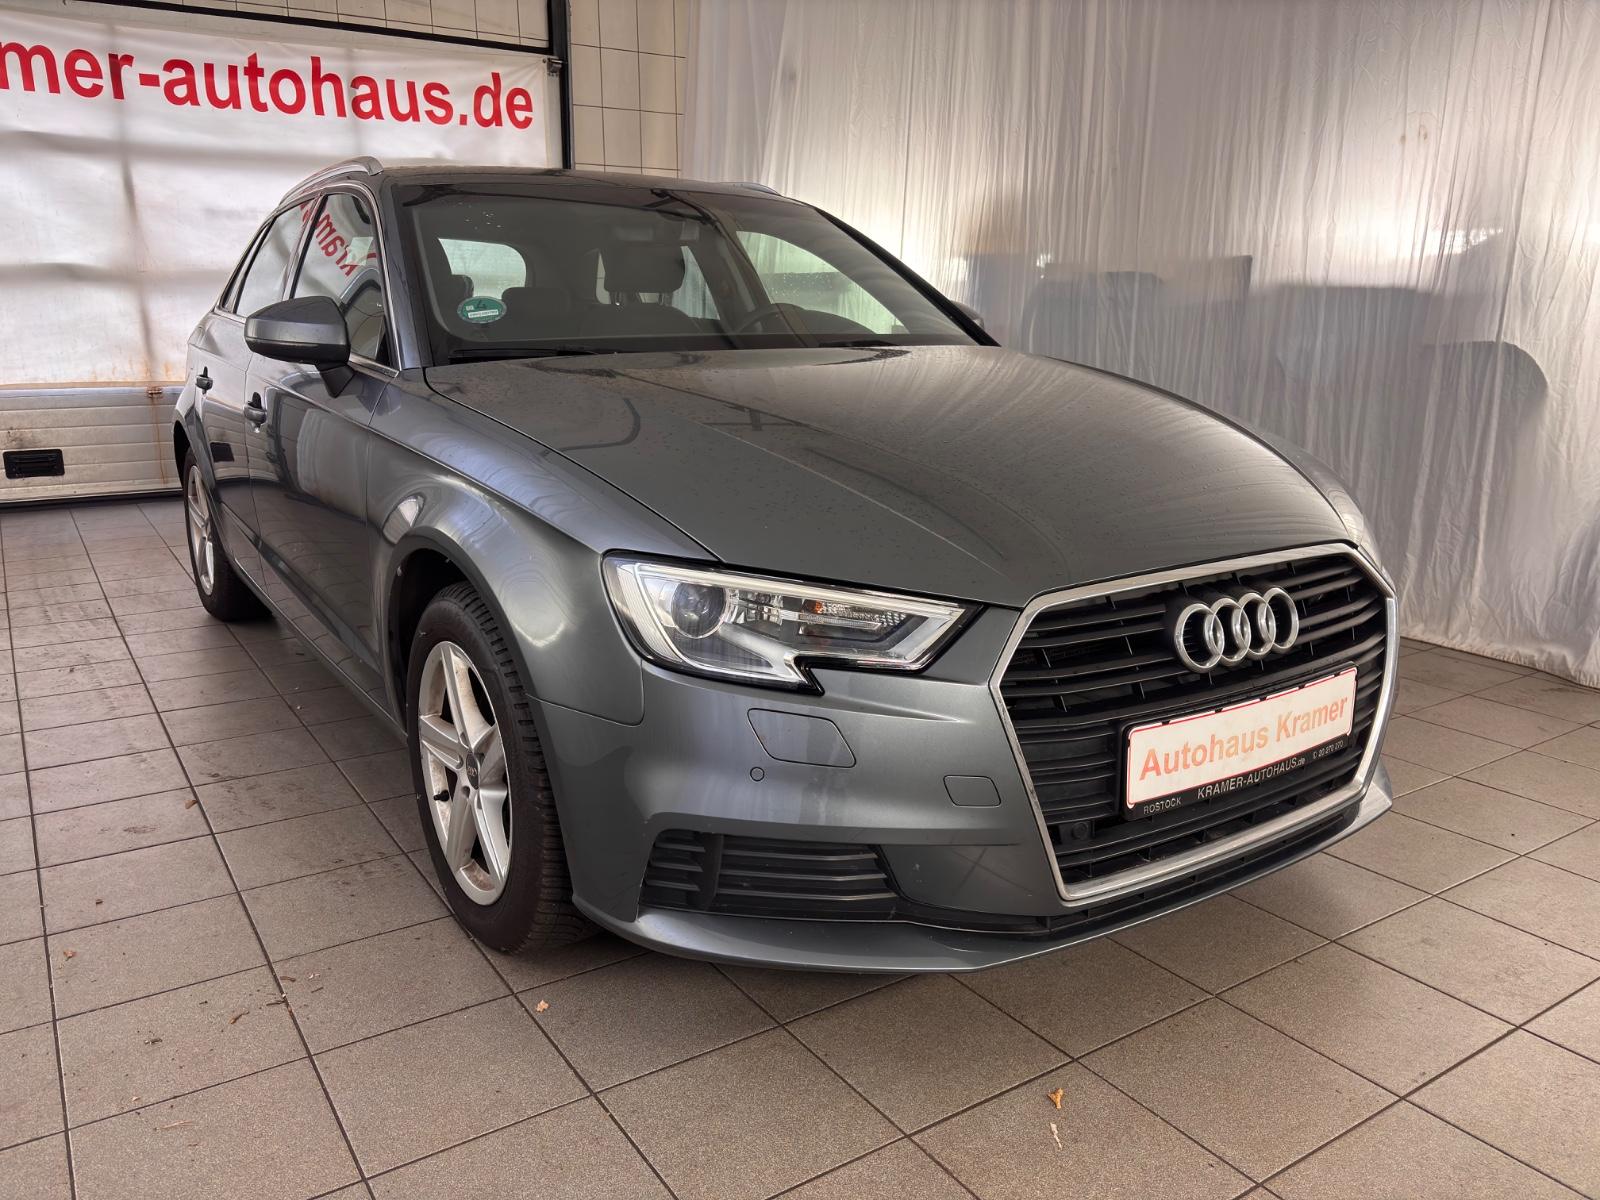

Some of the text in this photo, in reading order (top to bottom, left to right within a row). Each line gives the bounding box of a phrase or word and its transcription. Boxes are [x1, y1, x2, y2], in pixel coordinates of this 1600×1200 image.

[0, 41, 533, 129] mer-autohaus.de
[1139, 696, 1348, 781] Autohaus Kramer
[1143, 799, 1182, 815] ROSTOCK
[1197, 757, 1306, 800] KRAMER-AUTOHAUS.de
